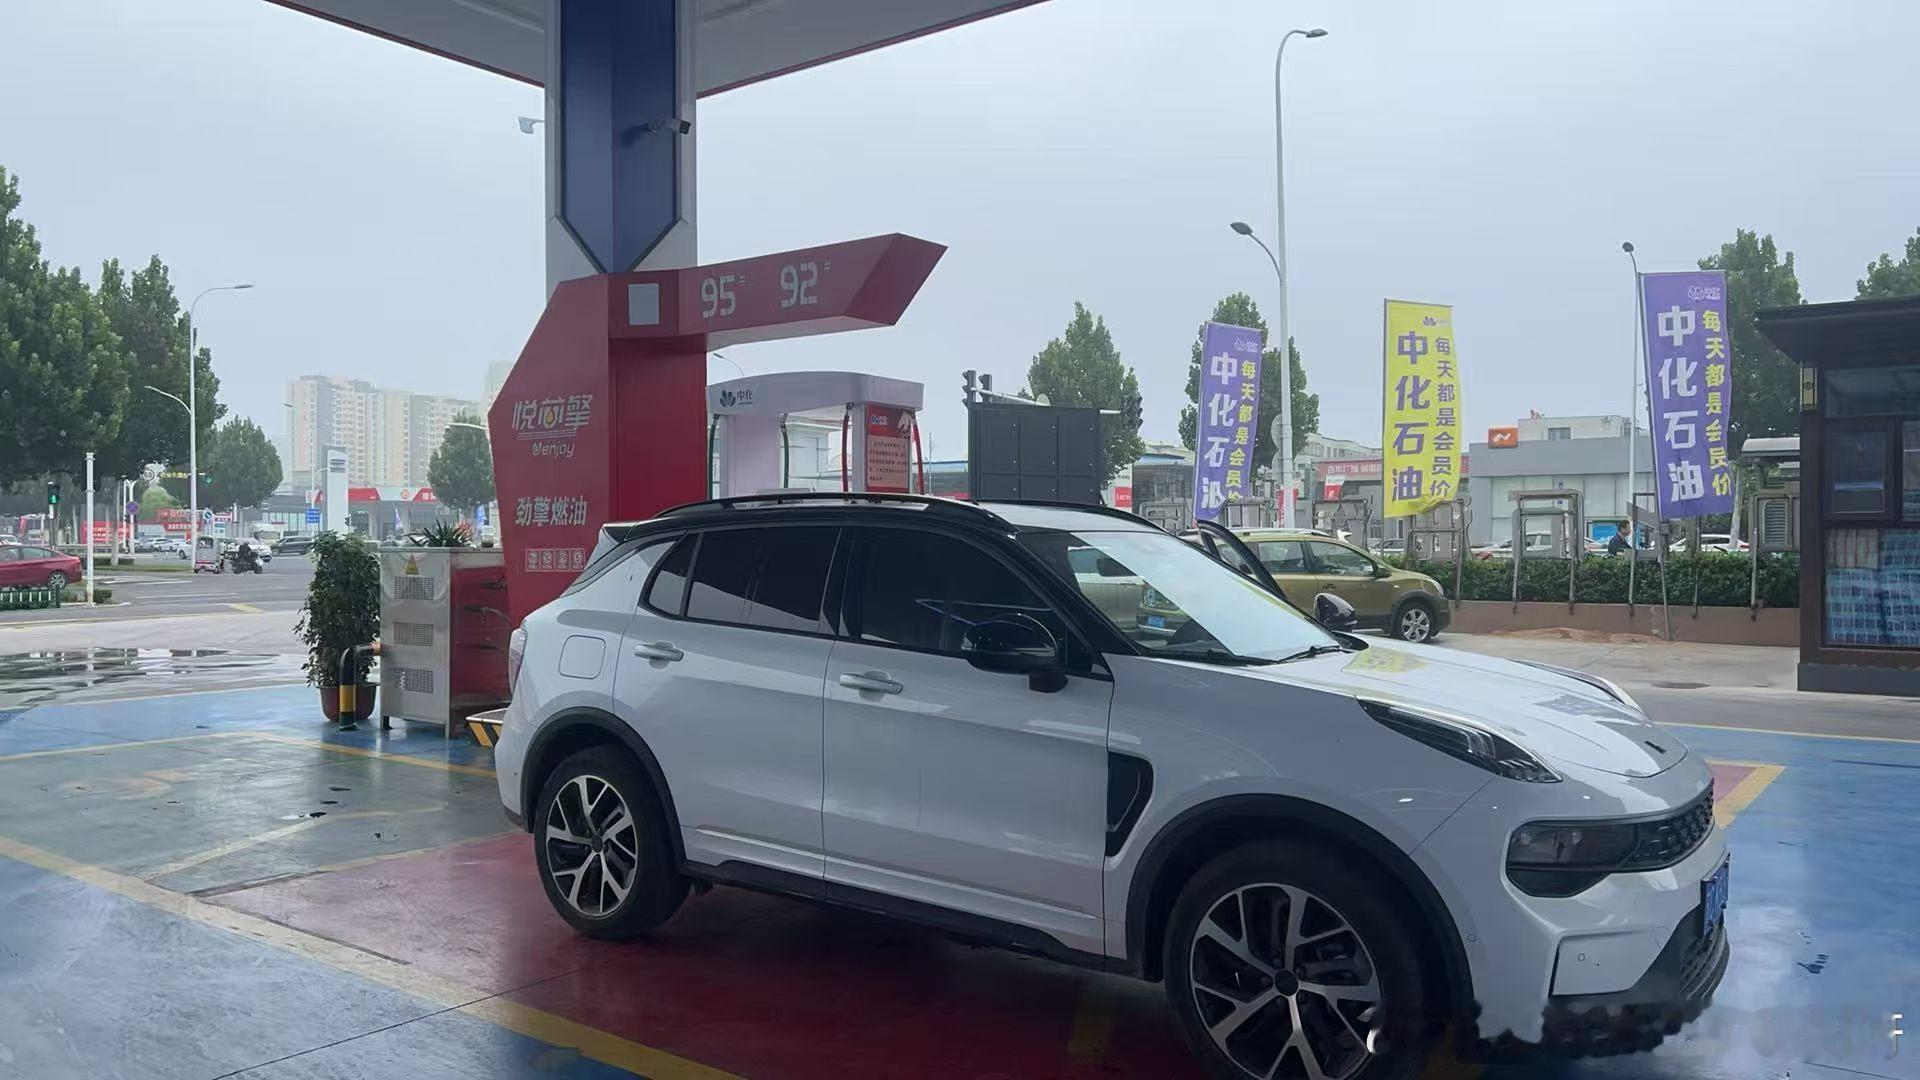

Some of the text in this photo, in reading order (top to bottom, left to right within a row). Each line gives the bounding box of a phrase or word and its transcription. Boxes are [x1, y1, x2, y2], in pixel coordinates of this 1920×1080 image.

[511, 395, 593, 431] 悦芯擎
[1201, 351, 1239, 509] 中化石油
[1391, 330, 1432, 502] 中化石油
[1429, 336, 1456, 498] 每天都是会员价
[1655, 305, 1705, 503] 中化石油
[1702, 309, 1732, 497] 每天都是会员价
[514, 494, 589, 528] 劲擎燃油
